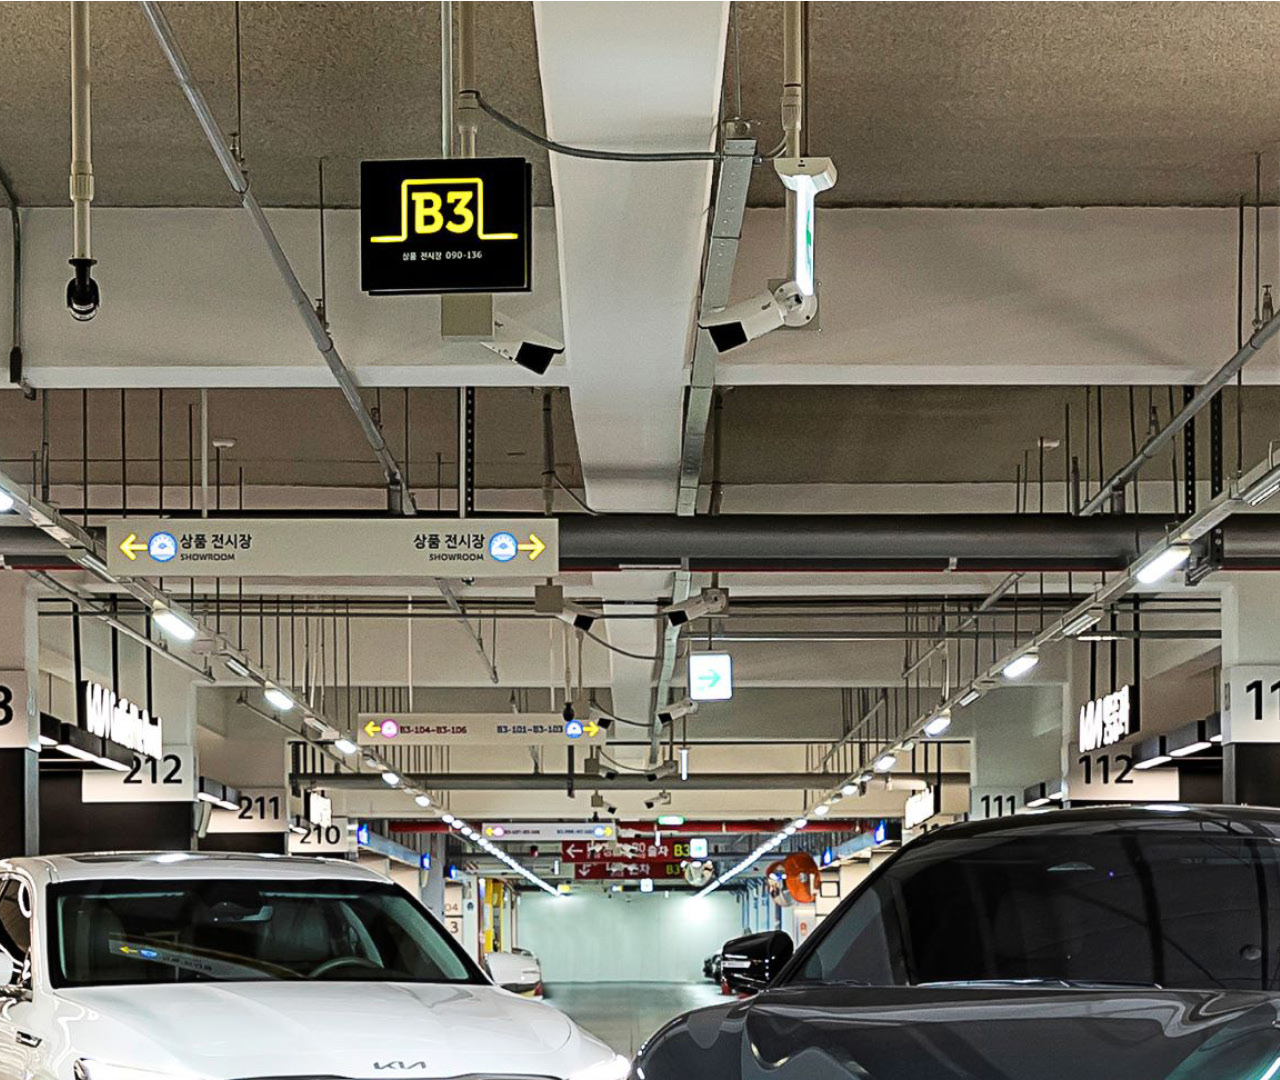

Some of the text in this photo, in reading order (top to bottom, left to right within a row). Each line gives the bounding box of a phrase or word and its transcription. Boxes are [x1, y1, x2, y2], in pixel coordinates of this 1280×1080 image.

[411, 191, 475, 234] B3
[180, 533, 252, 549] 상품 전시장
[414, 533, 485, 549] 상품 전시장
[180, 553, 236, 561] SHOWROOM
[428, 553, 484, 561] SHOWROOM
[122, 754, 183, 785] 212
[1078, 754, 1134, 784] 112
[238, 795, 280, 820] 211
[980, 795, 1016, 818] 111
[299, 825, 341, 845] 210
